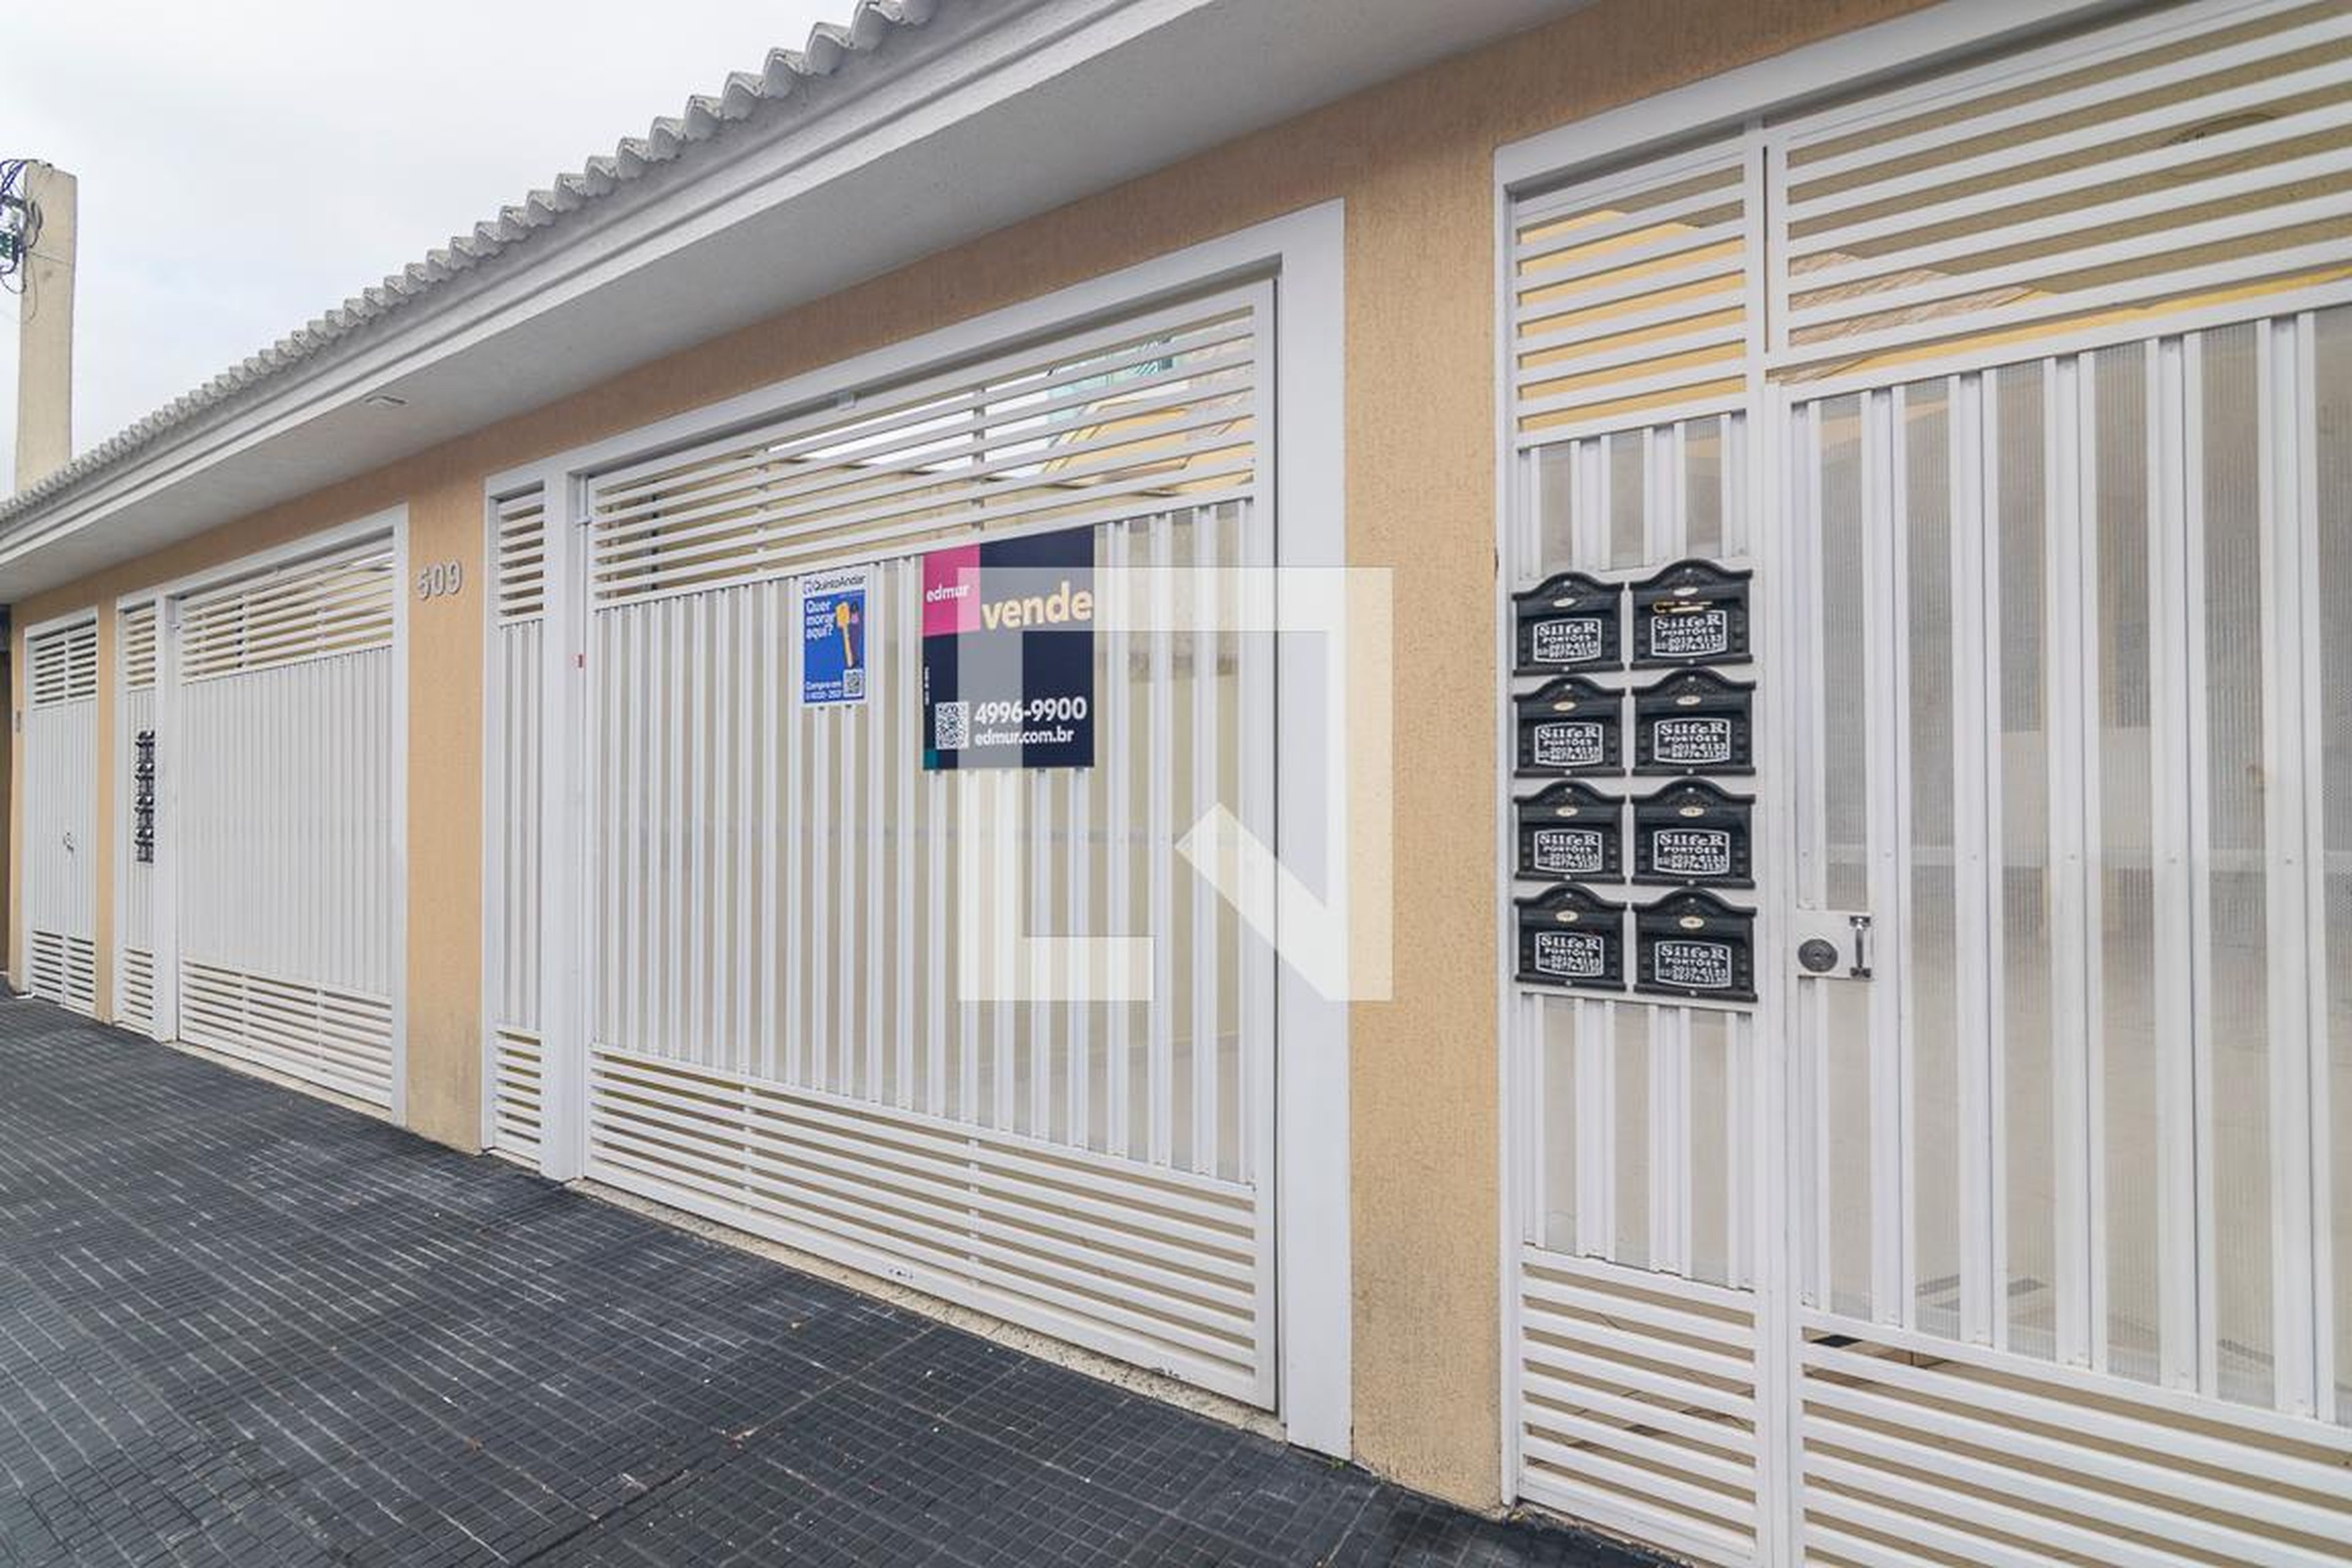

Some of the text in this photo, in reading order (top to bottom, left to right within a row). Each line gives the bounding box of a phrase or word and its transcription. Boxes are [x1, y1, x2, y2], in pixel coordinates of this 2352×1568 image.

[926, 584, 970, 602] edmur
[805, 600, 832, 613] Quer
[981, 580, 1094, 630] vende
[974, 696, 1087, 725] 4996-9900
[974, 725, 1074, 746] edmur.com.br
